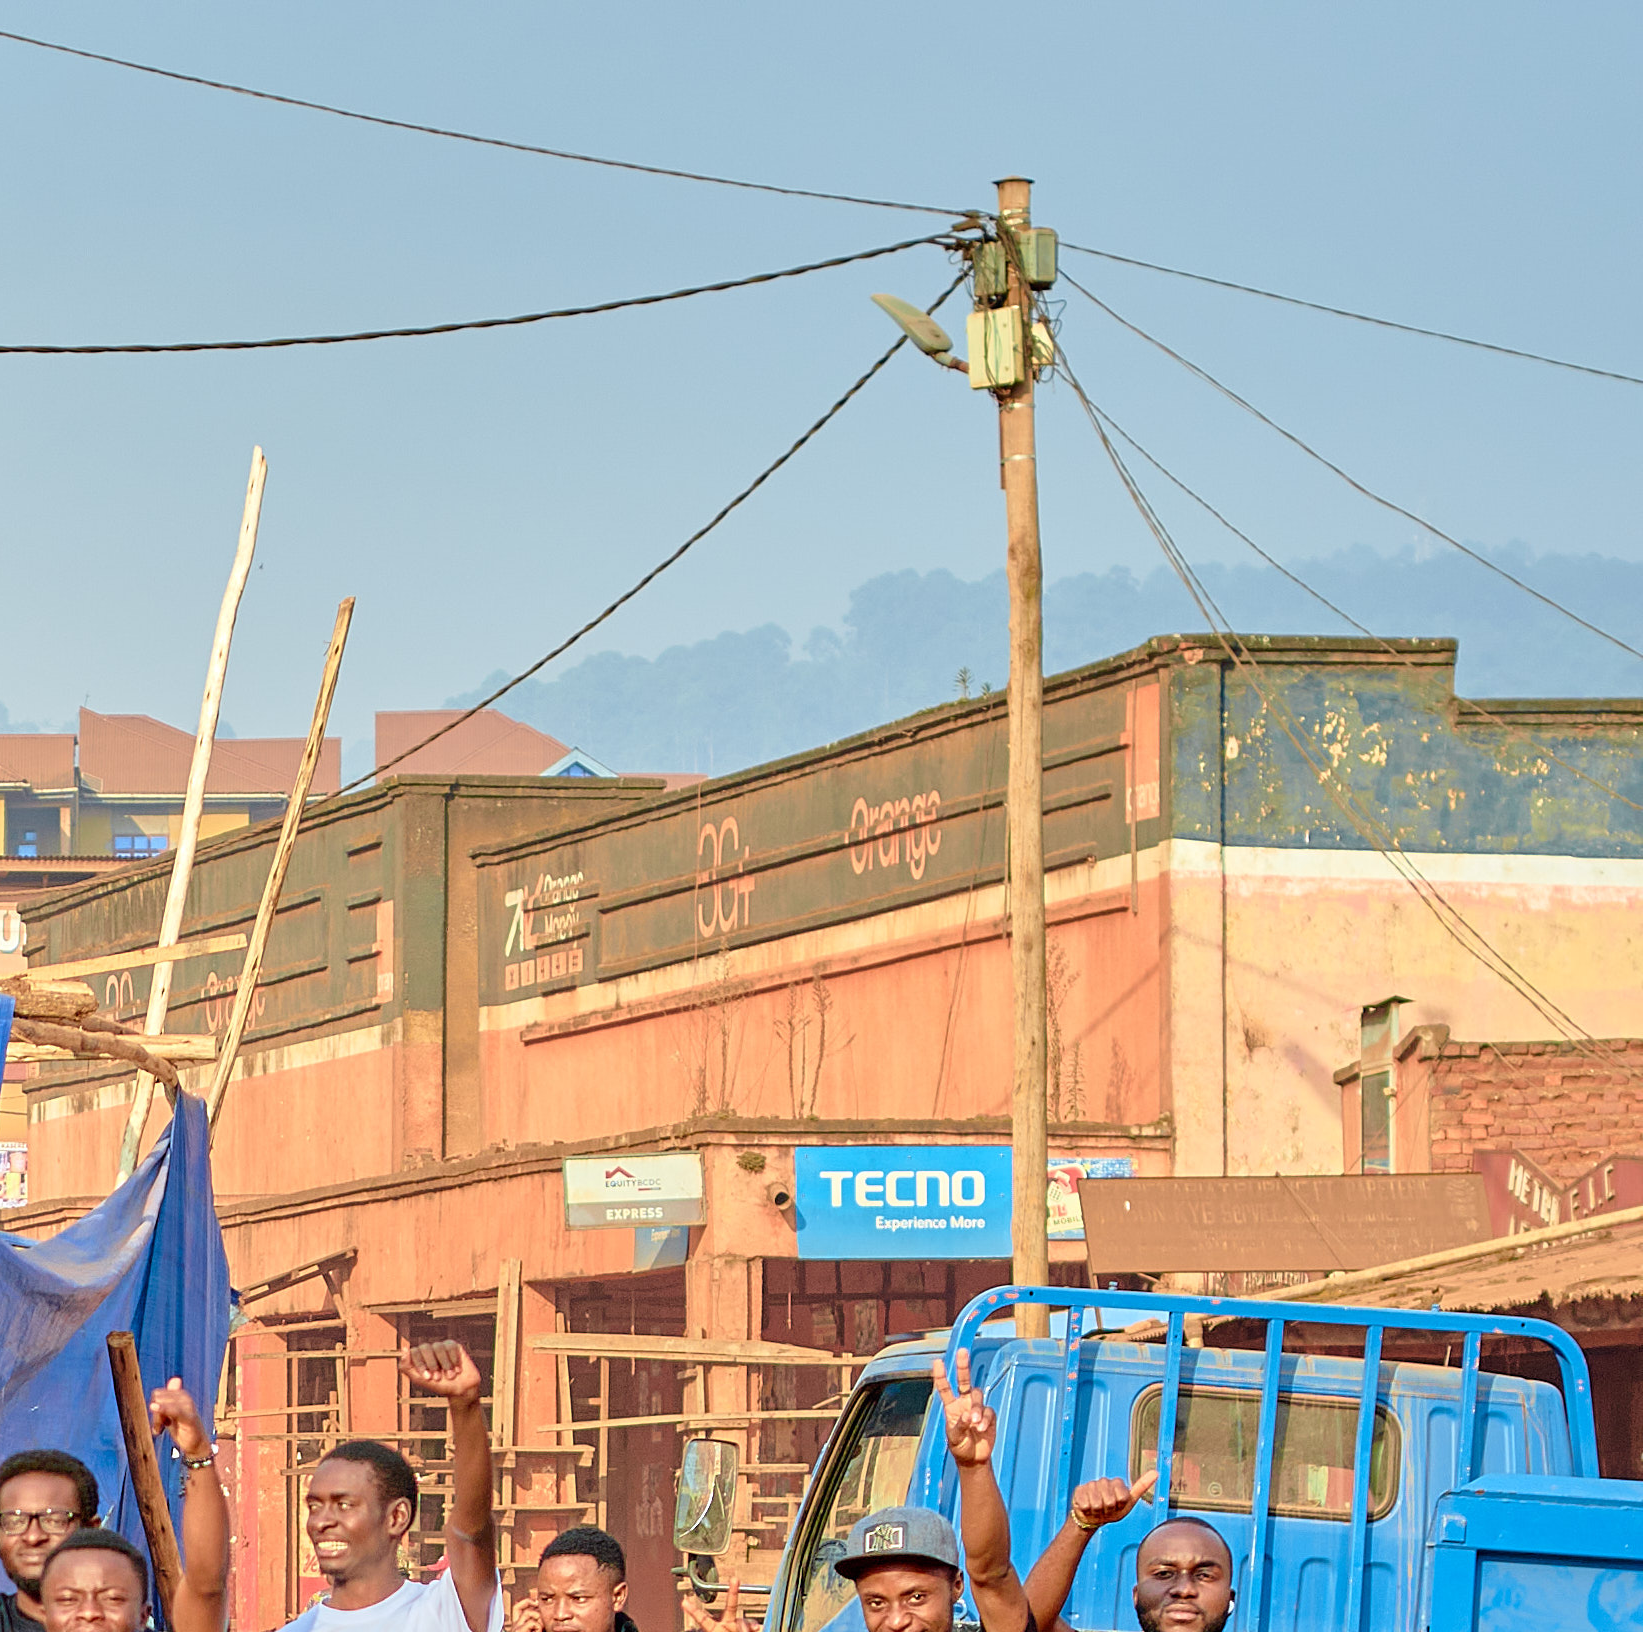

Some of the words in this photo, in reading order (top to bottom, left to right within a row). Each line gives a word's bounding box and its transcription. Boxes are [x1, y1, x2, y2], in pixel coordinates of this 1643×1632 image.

[844, 790, 942, 880] Orange
[605, 1178, 662, 1188] EQUITYBCDC
[819, 1169, 986, 1208] TECNO
[606, 1207, 664, 1220] EXPRESS
[1053, 1215, 1083, 1226] MOBIL
[875, 1215, 947, 1231] Experience
[950, 1215, 986, 1229] More
